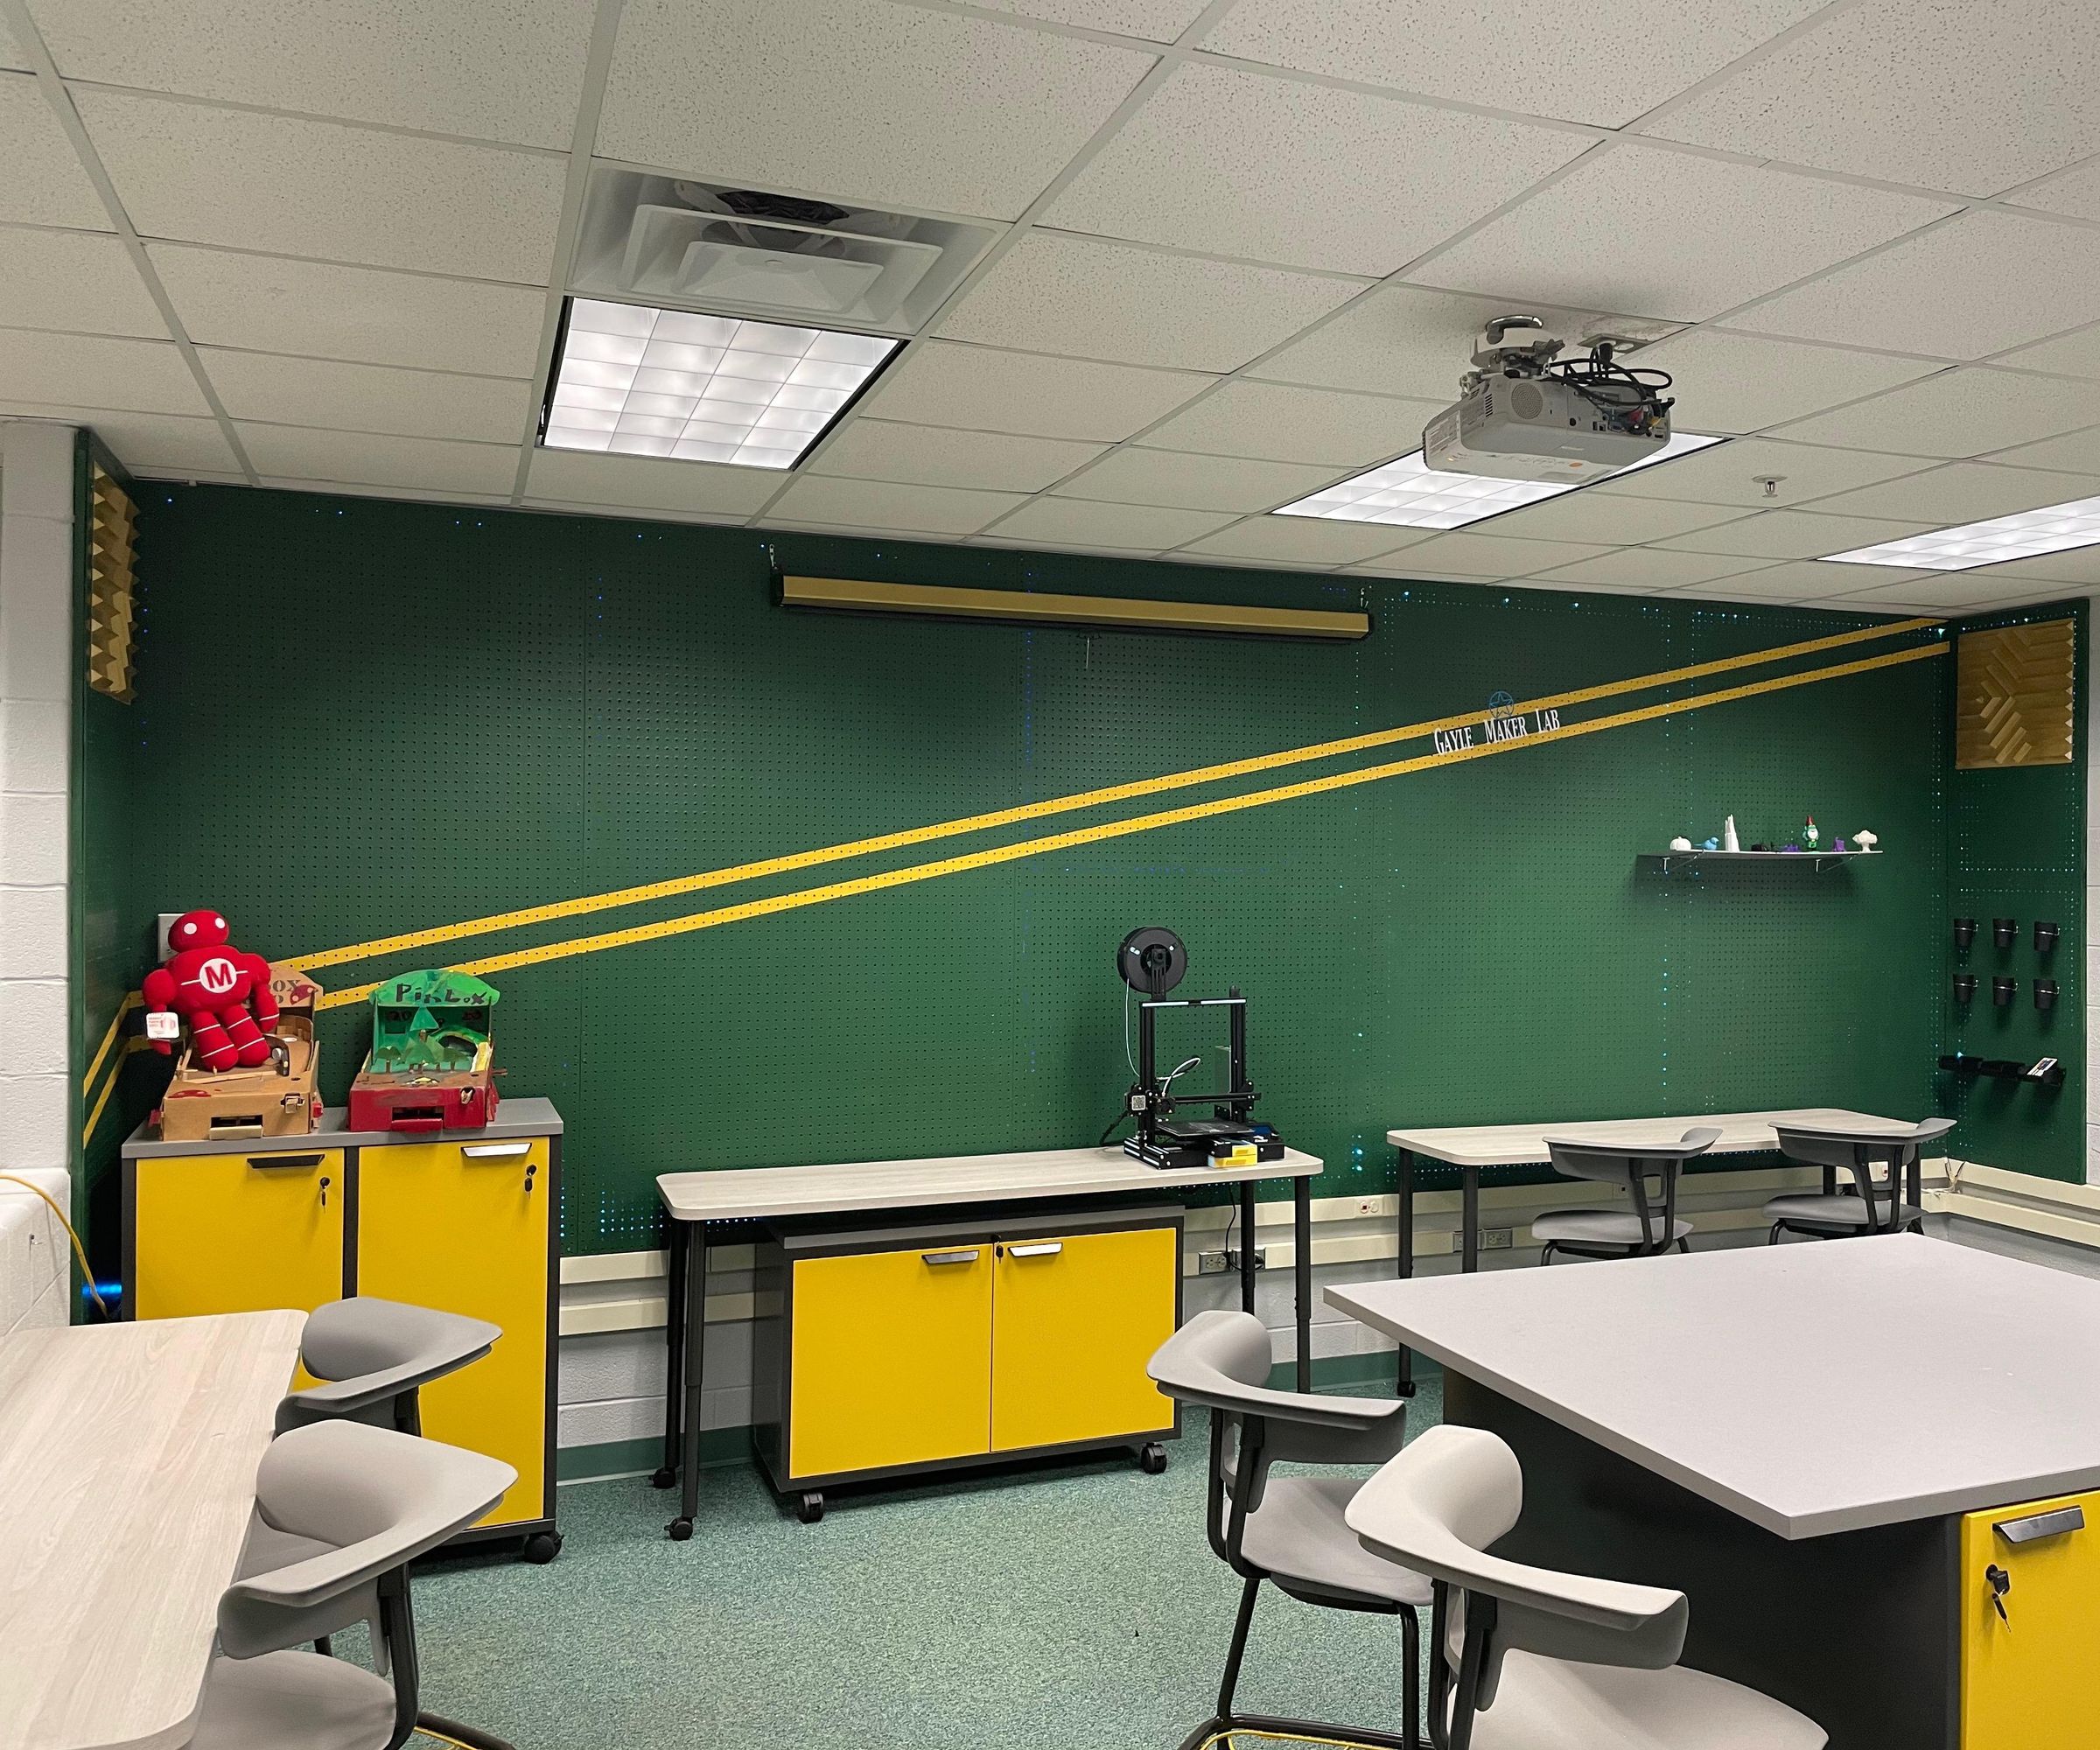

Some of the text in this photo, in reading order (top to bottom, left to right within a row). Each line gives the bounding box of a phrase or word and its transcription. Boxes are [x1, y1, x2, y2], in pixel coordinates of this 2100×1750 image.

[1484, 716, 1529, 744] MAKER
[1535, 708, 1560, 733] LAB
[205, 963, 233, 989] M
